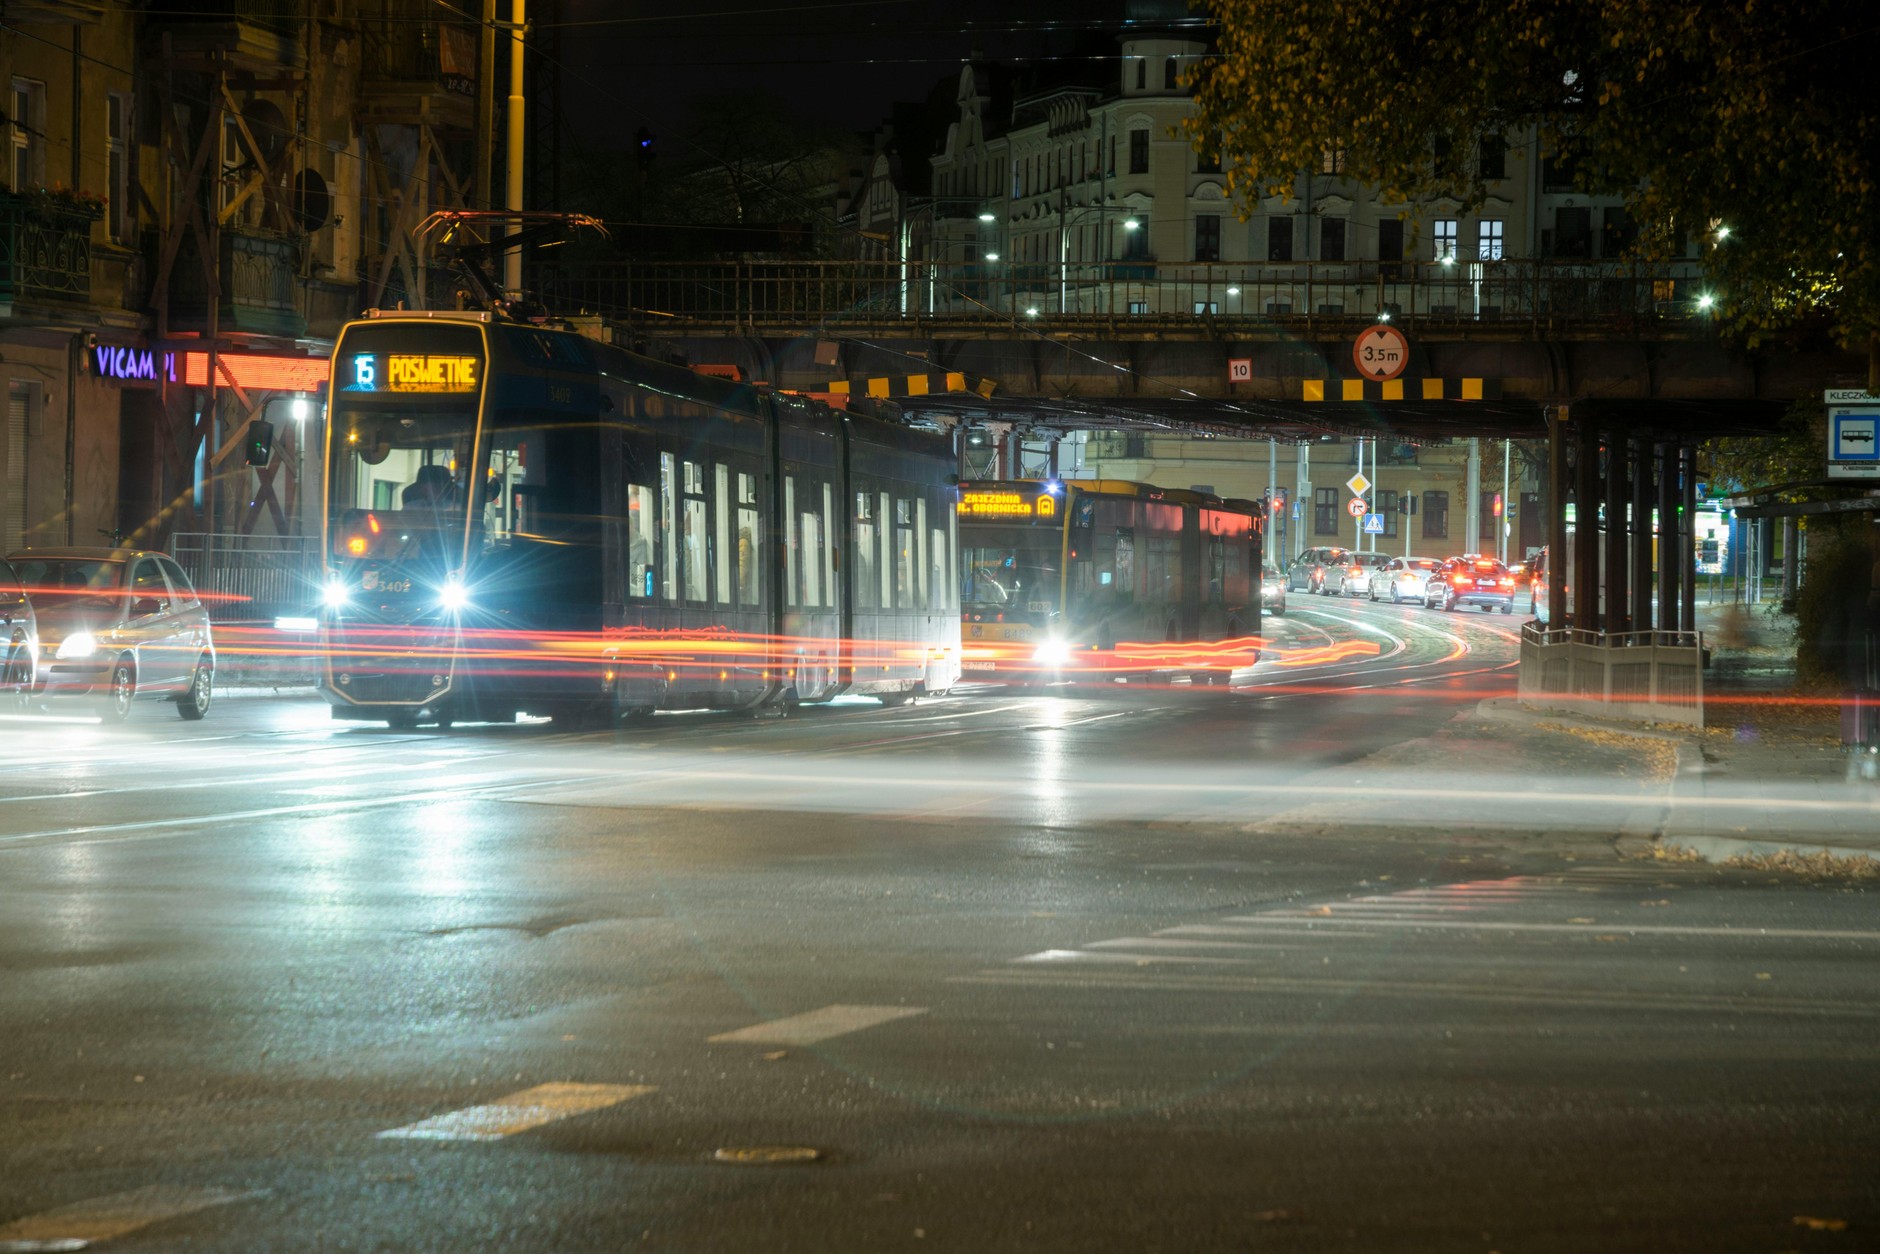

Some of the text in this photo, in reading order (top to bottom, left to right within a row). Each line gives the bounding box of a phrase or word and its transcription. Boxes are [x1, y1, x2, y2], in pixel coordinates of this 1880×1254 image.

[354, 357, 374, 383] 15
[1233, 365, 1247, 376] 10
[964, 494, 1020, 503] ZAJEZDNIA
[973, 503, 1031, 513] OBORNICKA
